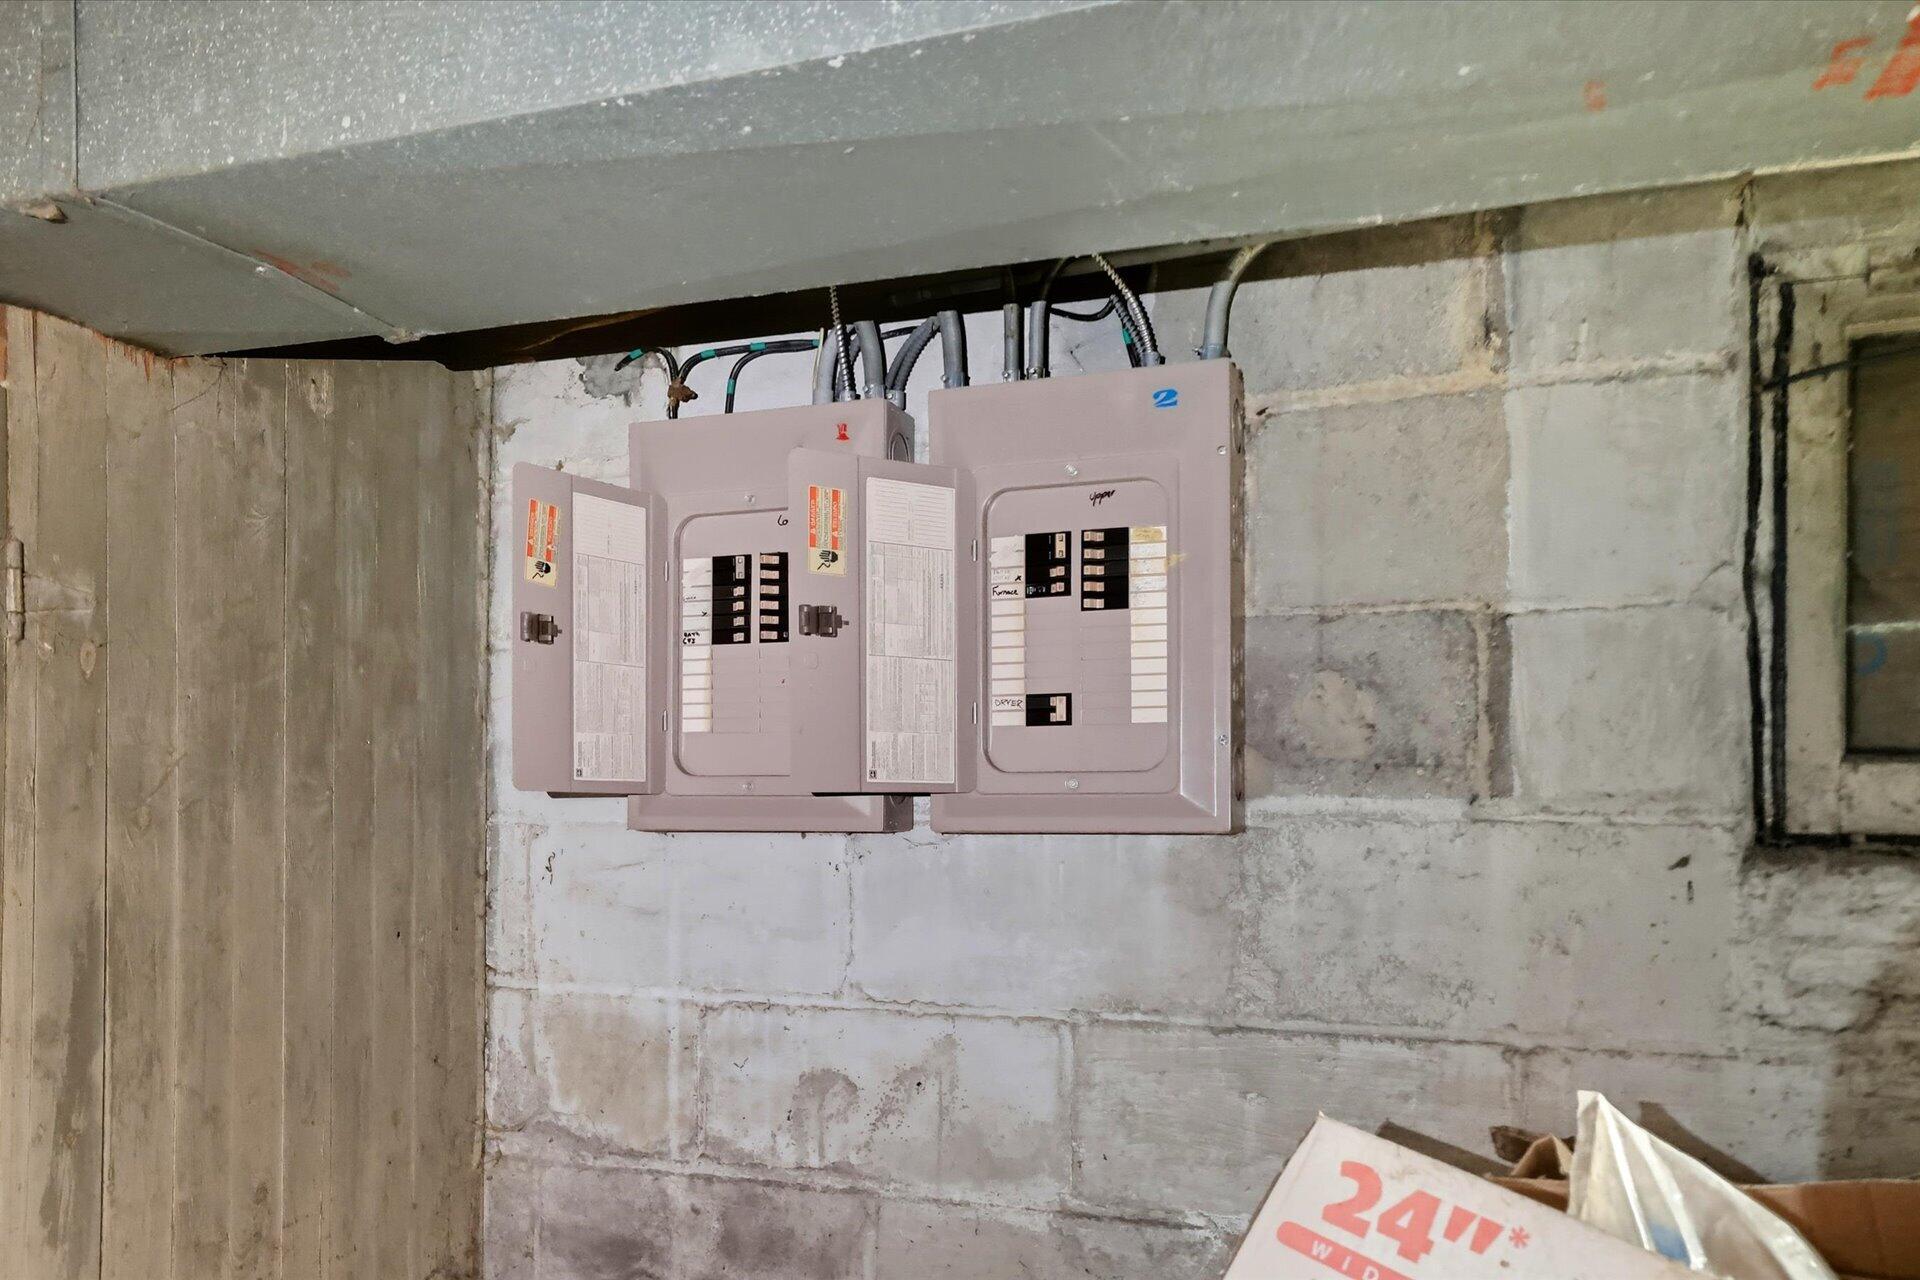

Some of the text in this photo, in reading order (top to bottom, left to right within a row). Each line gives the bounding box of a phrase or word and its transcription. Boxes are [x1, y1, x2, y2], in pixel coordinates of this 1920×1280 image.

[1152, 388, 1178, 408] 2
[992, 585, 1019, 597] Furnace
[994, 698, 1024, 712] DRYER
